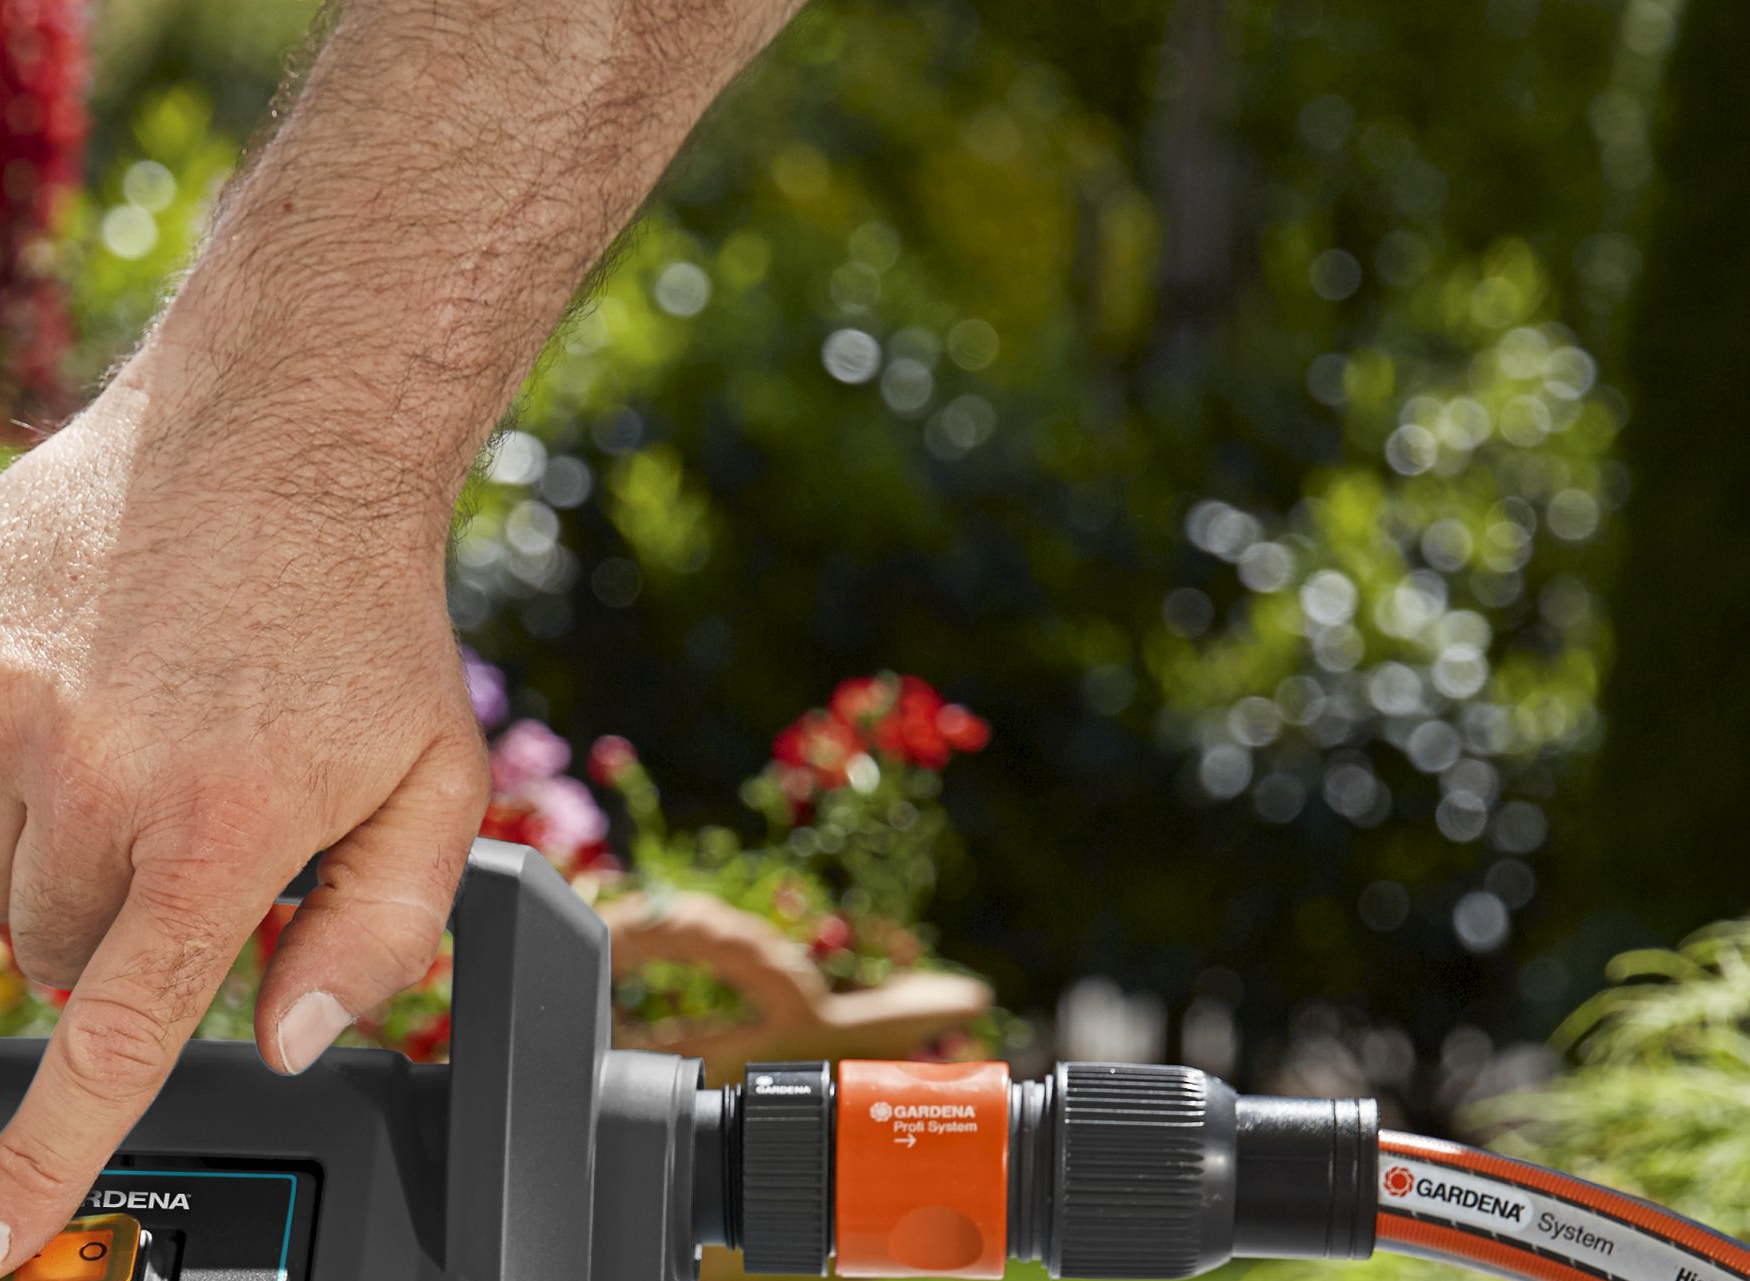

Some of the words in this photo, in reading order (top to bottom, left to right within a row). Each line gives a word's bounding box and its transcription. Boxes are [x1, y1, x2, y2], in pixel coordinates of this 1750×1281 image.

[893, 1104, 976, 1118] GARDENA
[893, 1120, 925, 1132] Profi
[927, 1120, 978, 1134] System
[81, 1190, 190, 1210] RDENA
[1416, 1178, 1523, 1223] GARDENA
[1538, 1211, 1615, 1256] System
